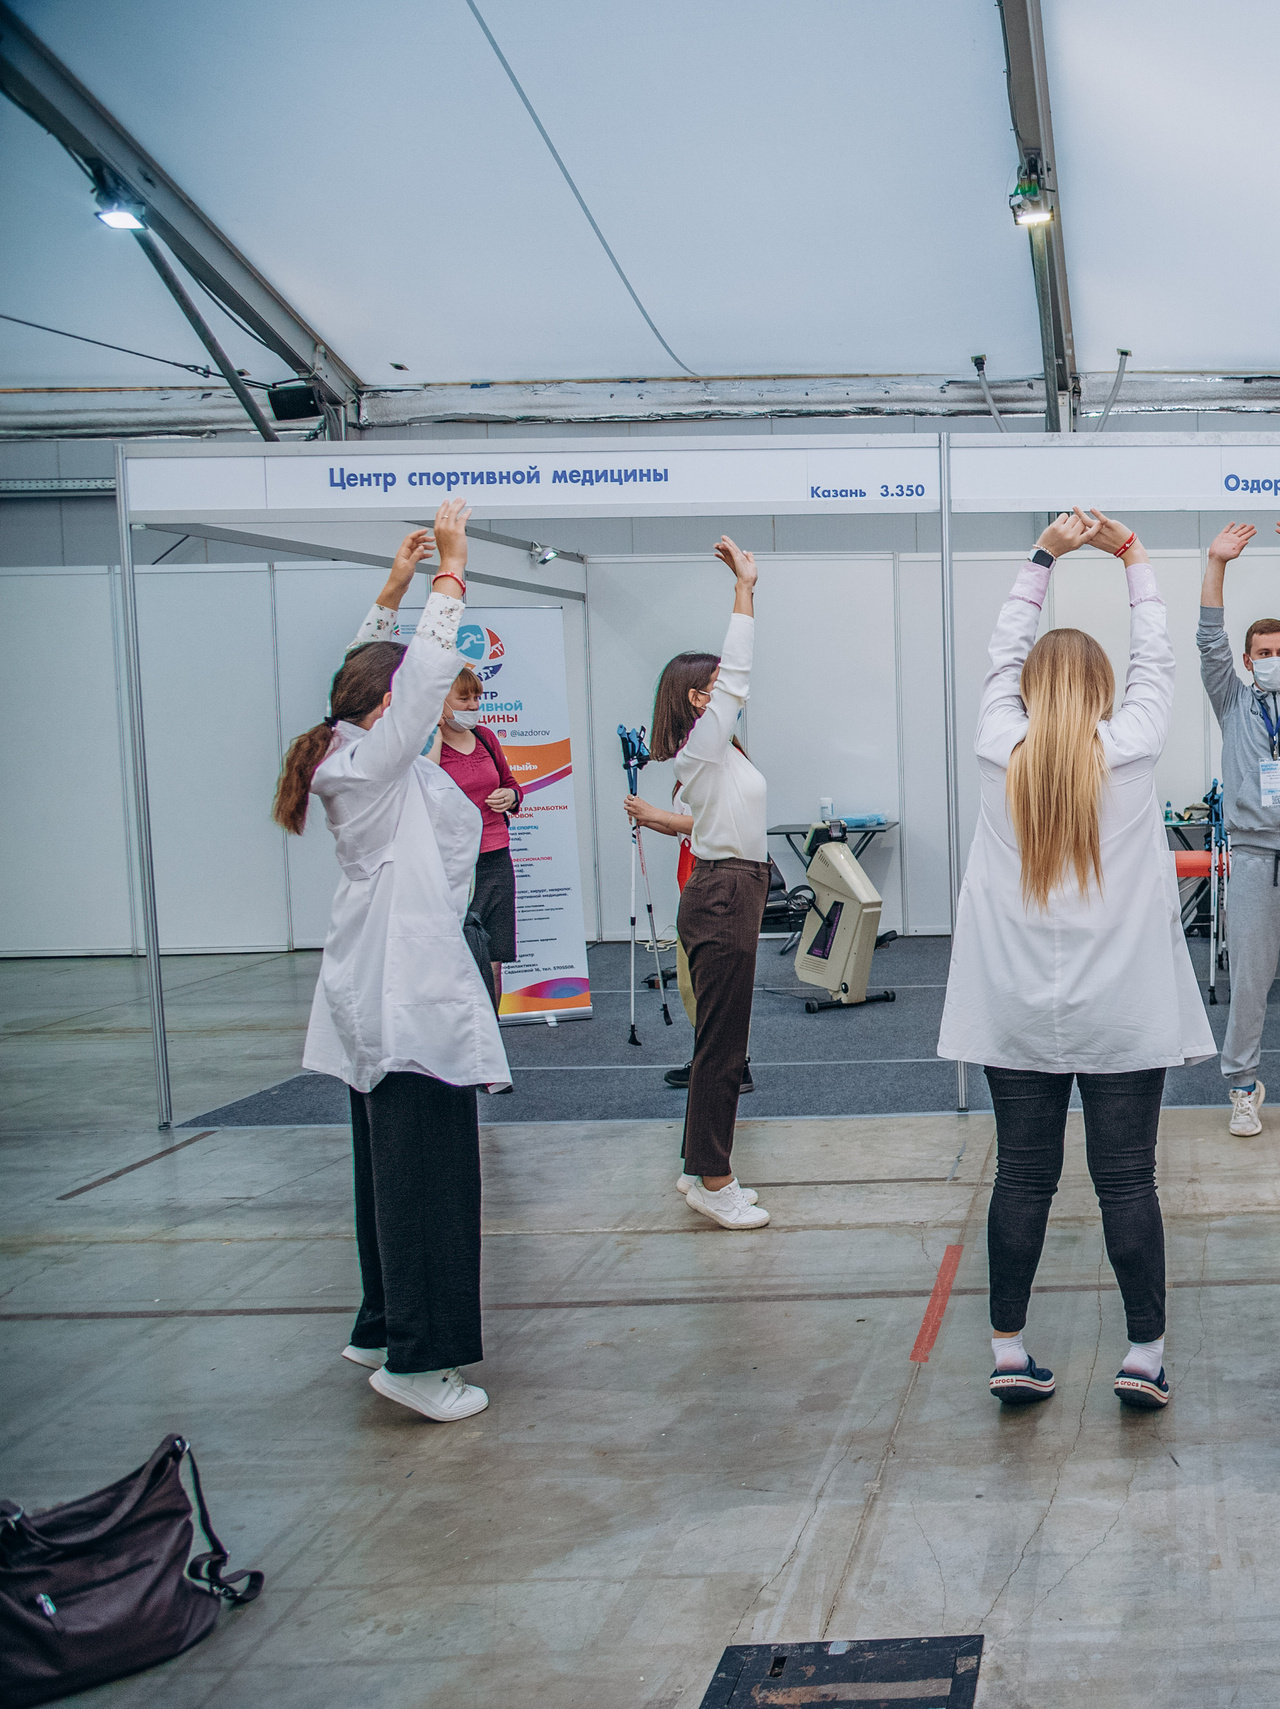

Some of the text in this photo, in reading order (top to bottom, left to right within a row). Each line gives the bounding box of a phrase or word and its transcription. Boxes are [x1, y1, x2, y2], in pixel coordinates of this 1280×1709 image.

[328, 465, 669, 492] Центр спортивной медицины
[810, 484, 925, 498] Казань 3.350
[478, 700, 523, 712] ИВНОЙ
[478, 714, 518, 725] ЦИНЫ
